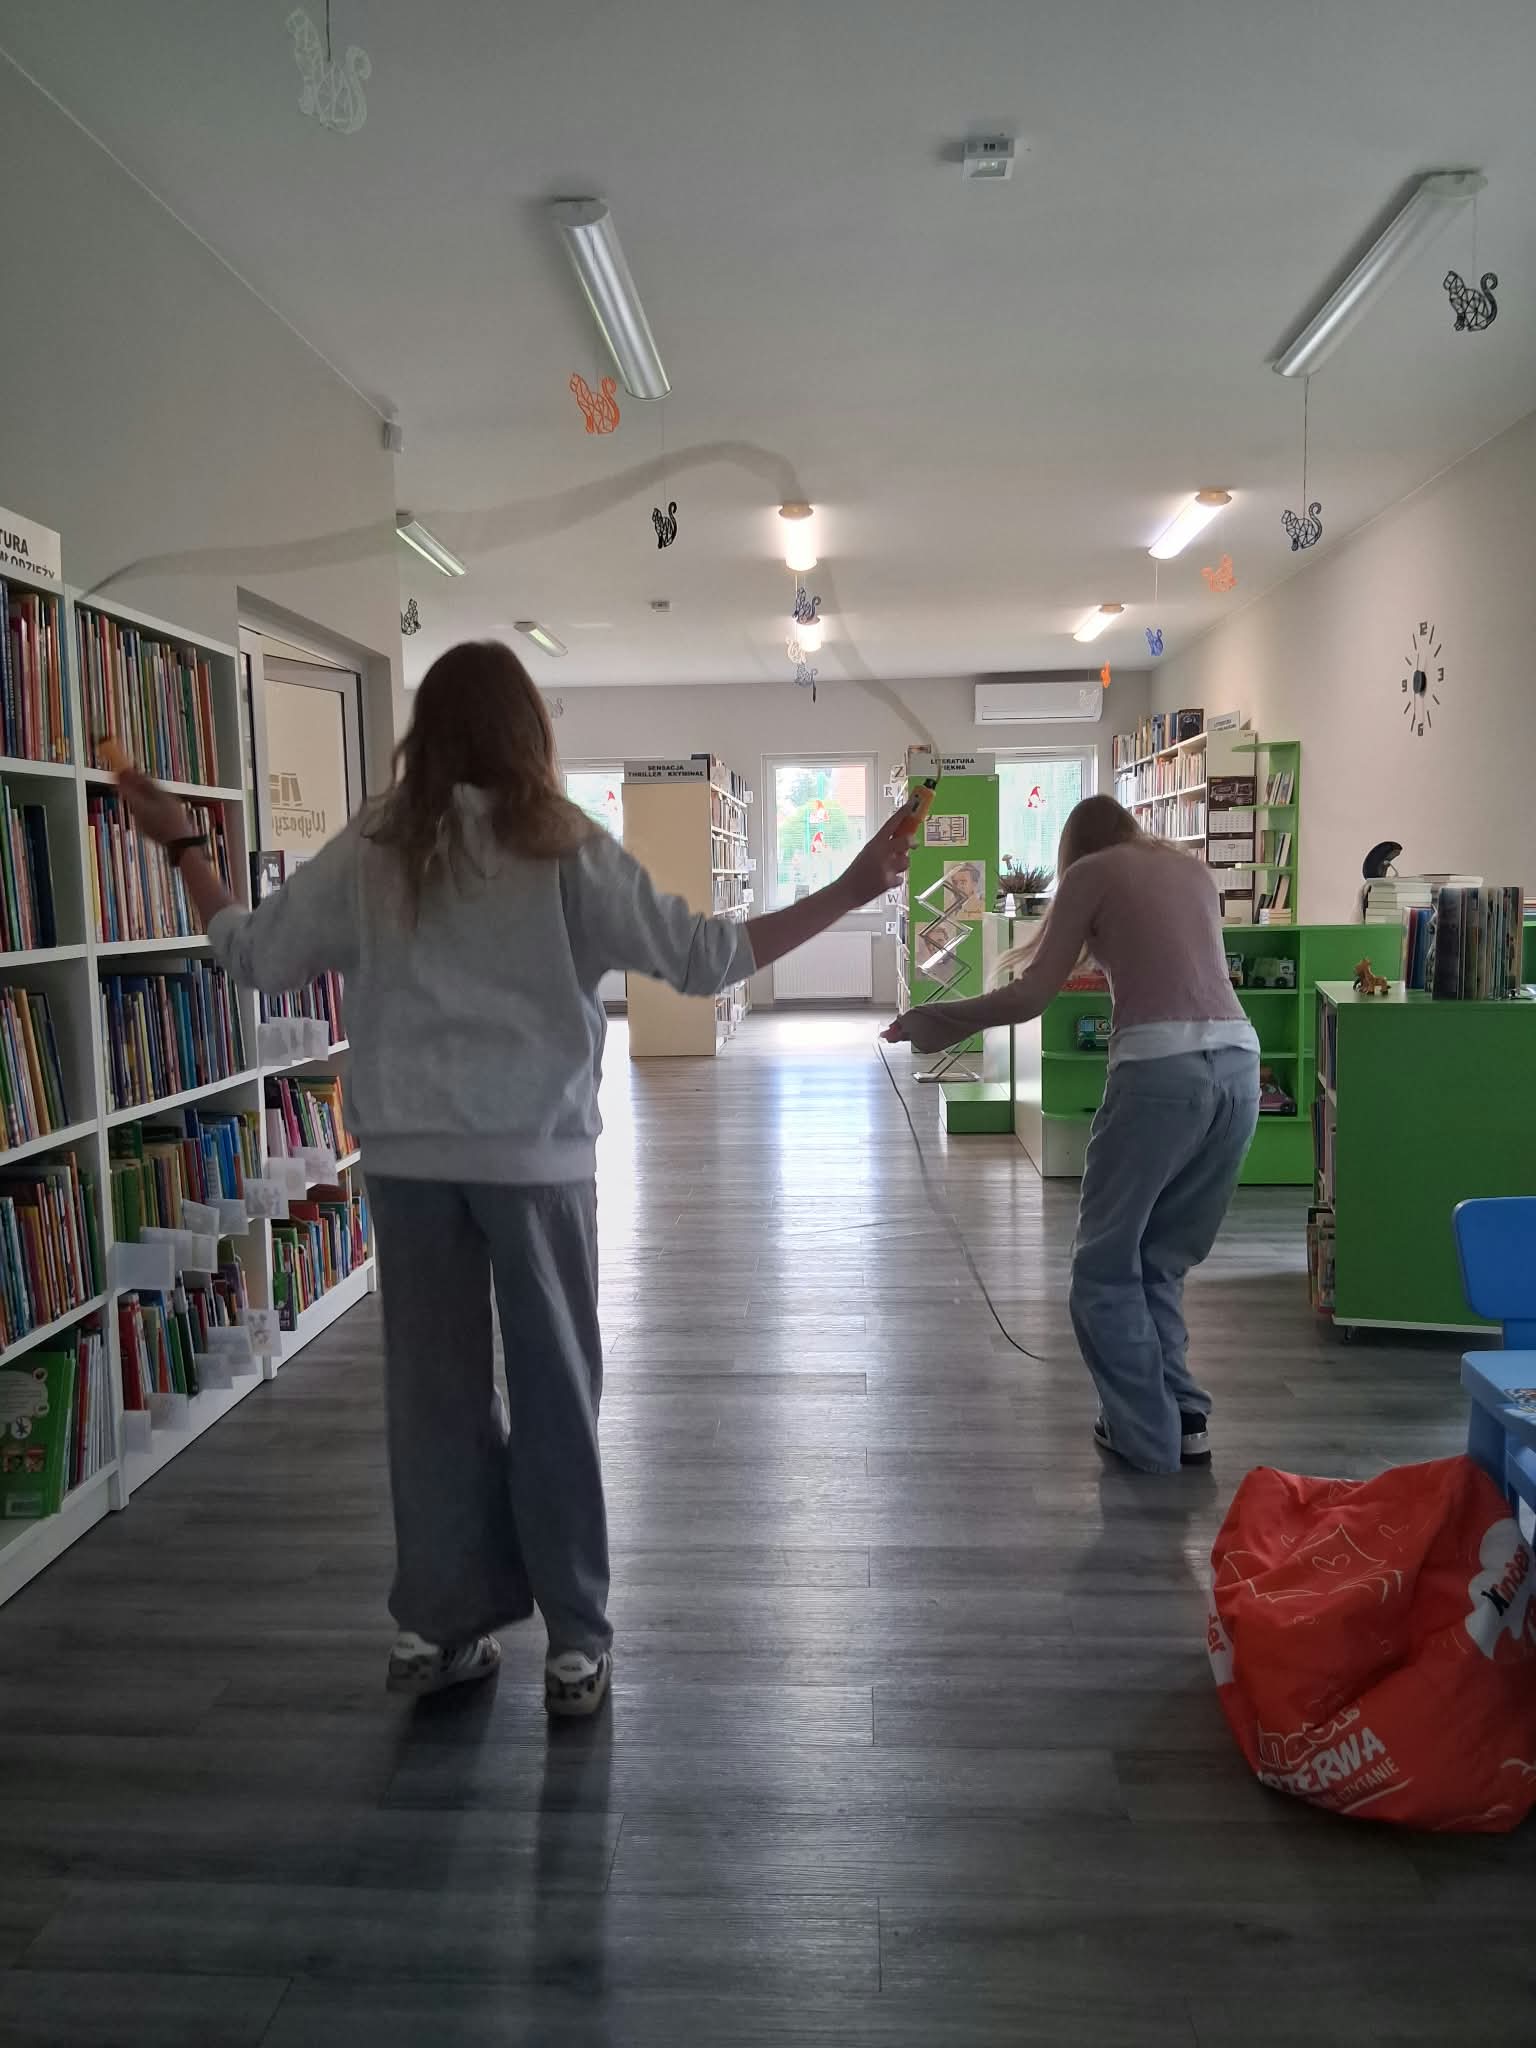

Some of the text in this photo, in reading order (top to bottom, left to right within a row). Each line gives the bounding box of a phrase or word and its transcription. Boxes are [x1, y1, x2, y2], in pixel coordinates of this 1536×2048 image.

[1438, 667, 1445, 682] 3
[1401, 679, 1408, 693] 9
[1417, 722, 1424, 737] 6
